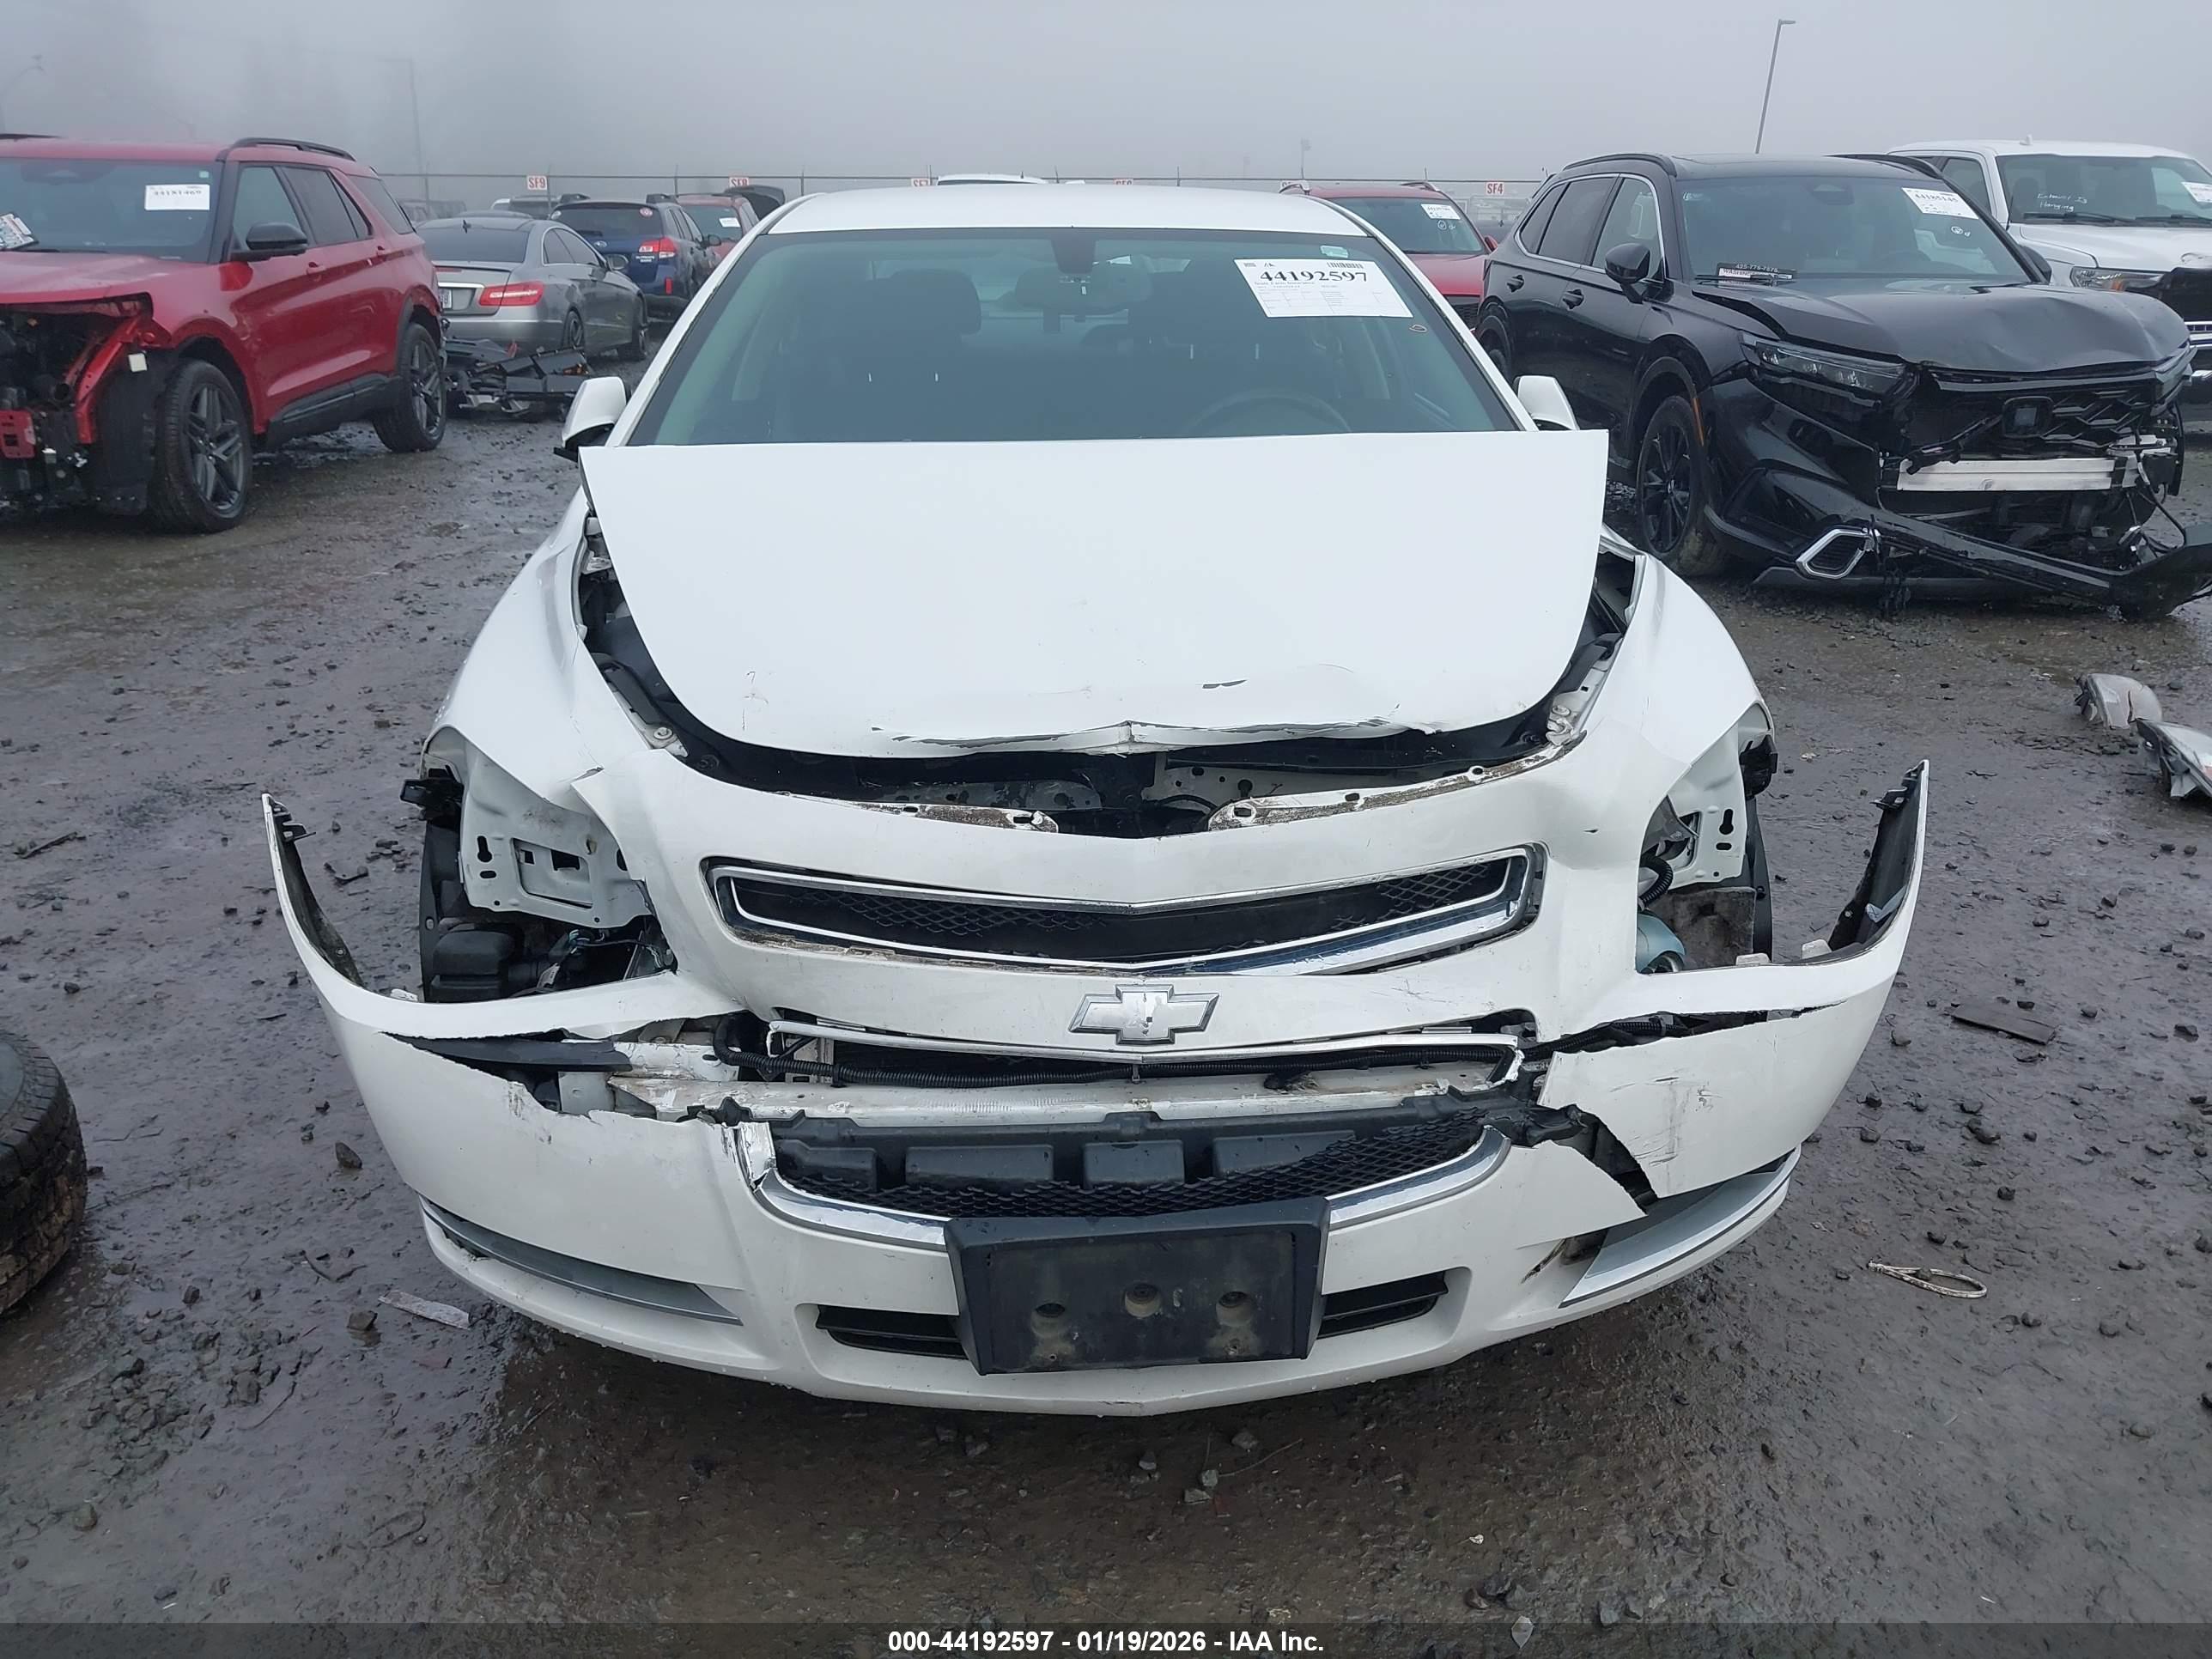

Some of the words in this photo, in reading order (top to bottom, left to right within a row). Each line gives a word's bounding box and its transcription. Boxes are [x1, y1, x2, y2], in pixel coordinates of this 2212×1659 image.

[529, 177, 546, 189] SF9
[1487, 183, 1504, 195] SF4
[1260, 270, 1367, 283] 44192597
